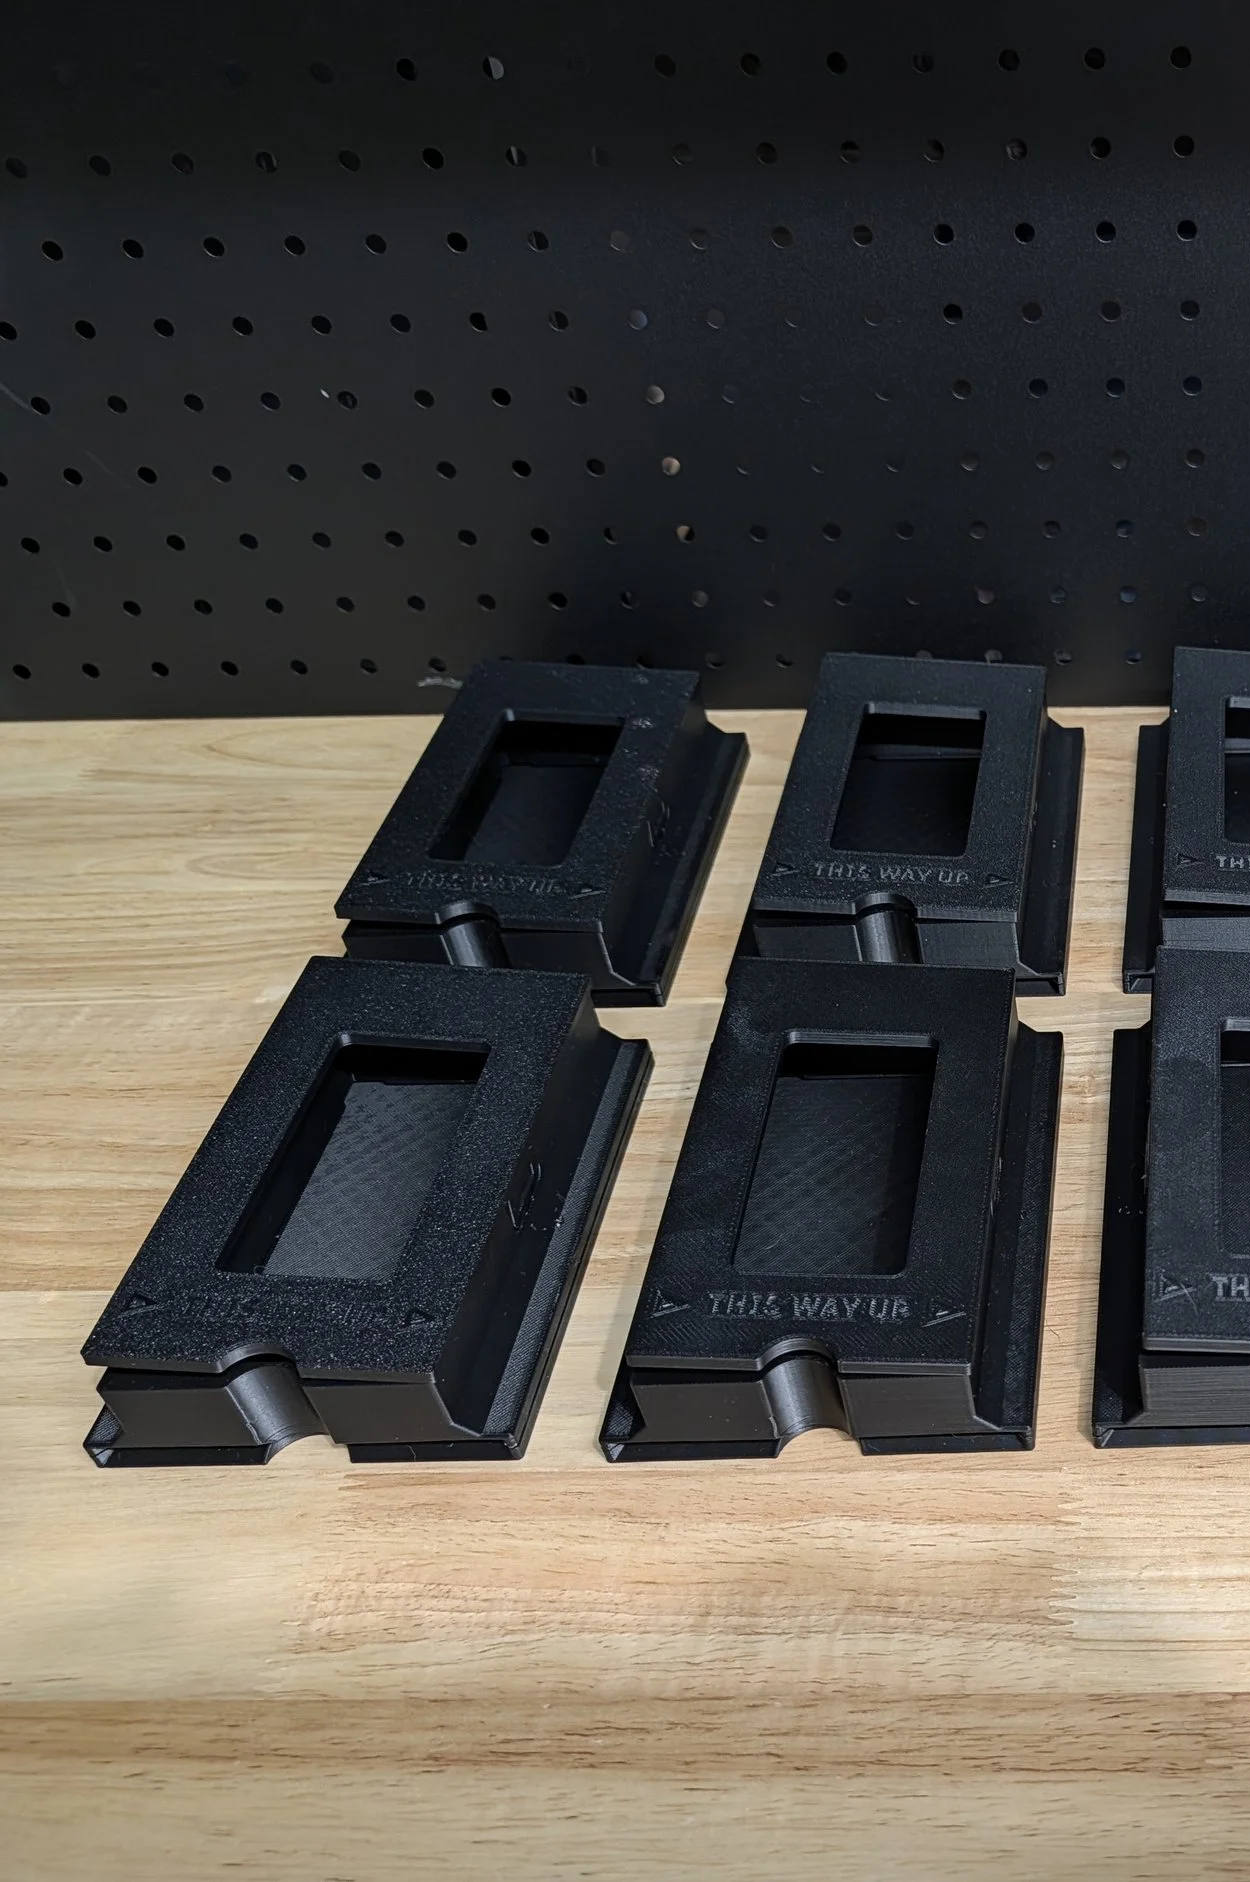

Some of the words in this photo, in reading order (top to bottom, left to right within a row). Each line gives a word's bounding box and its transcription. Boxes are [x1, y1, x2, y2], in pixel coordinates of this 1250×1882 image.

[814, 862, 870, 880] THIS
[879, 865, 933, 883] WAY
[938, 869, 969, 885] UP
[708, 1291, 783, 1320] THIS
[791, 1293, 861, 1321] WAY
